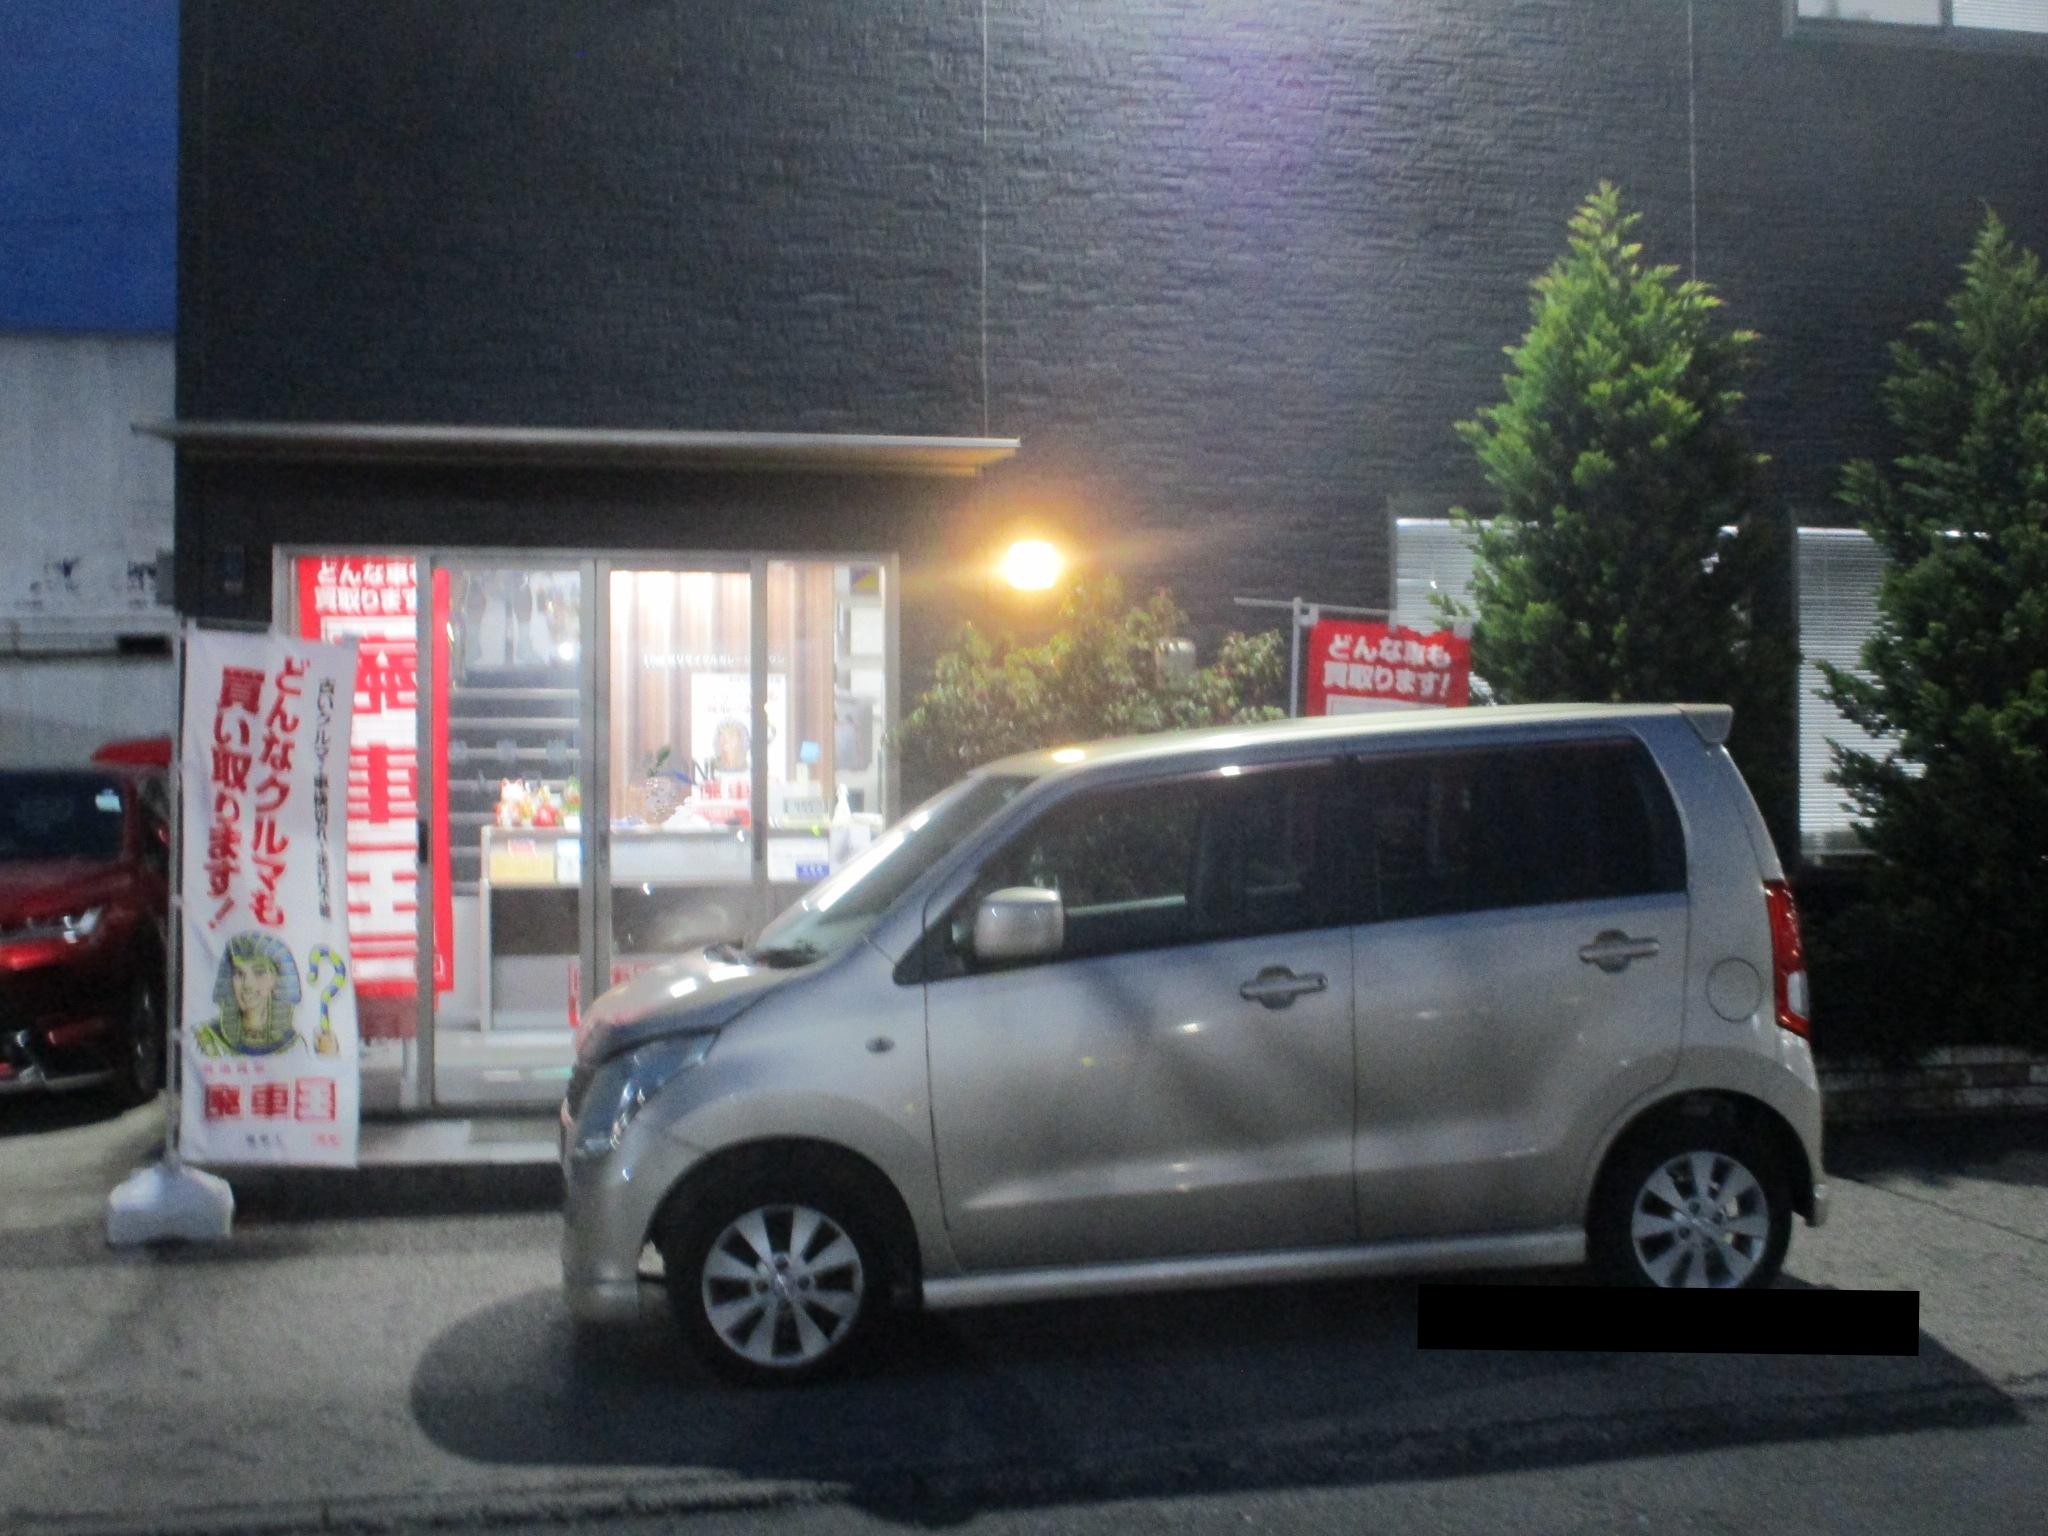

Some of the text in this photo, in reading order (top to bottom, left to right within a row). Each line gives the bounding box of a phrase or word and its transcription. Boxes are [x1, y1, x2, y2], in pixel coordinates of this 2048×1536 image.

[1328, 634, 1451, 668] どんな車も
[250, 655, 310, 926] どんなクルマも
